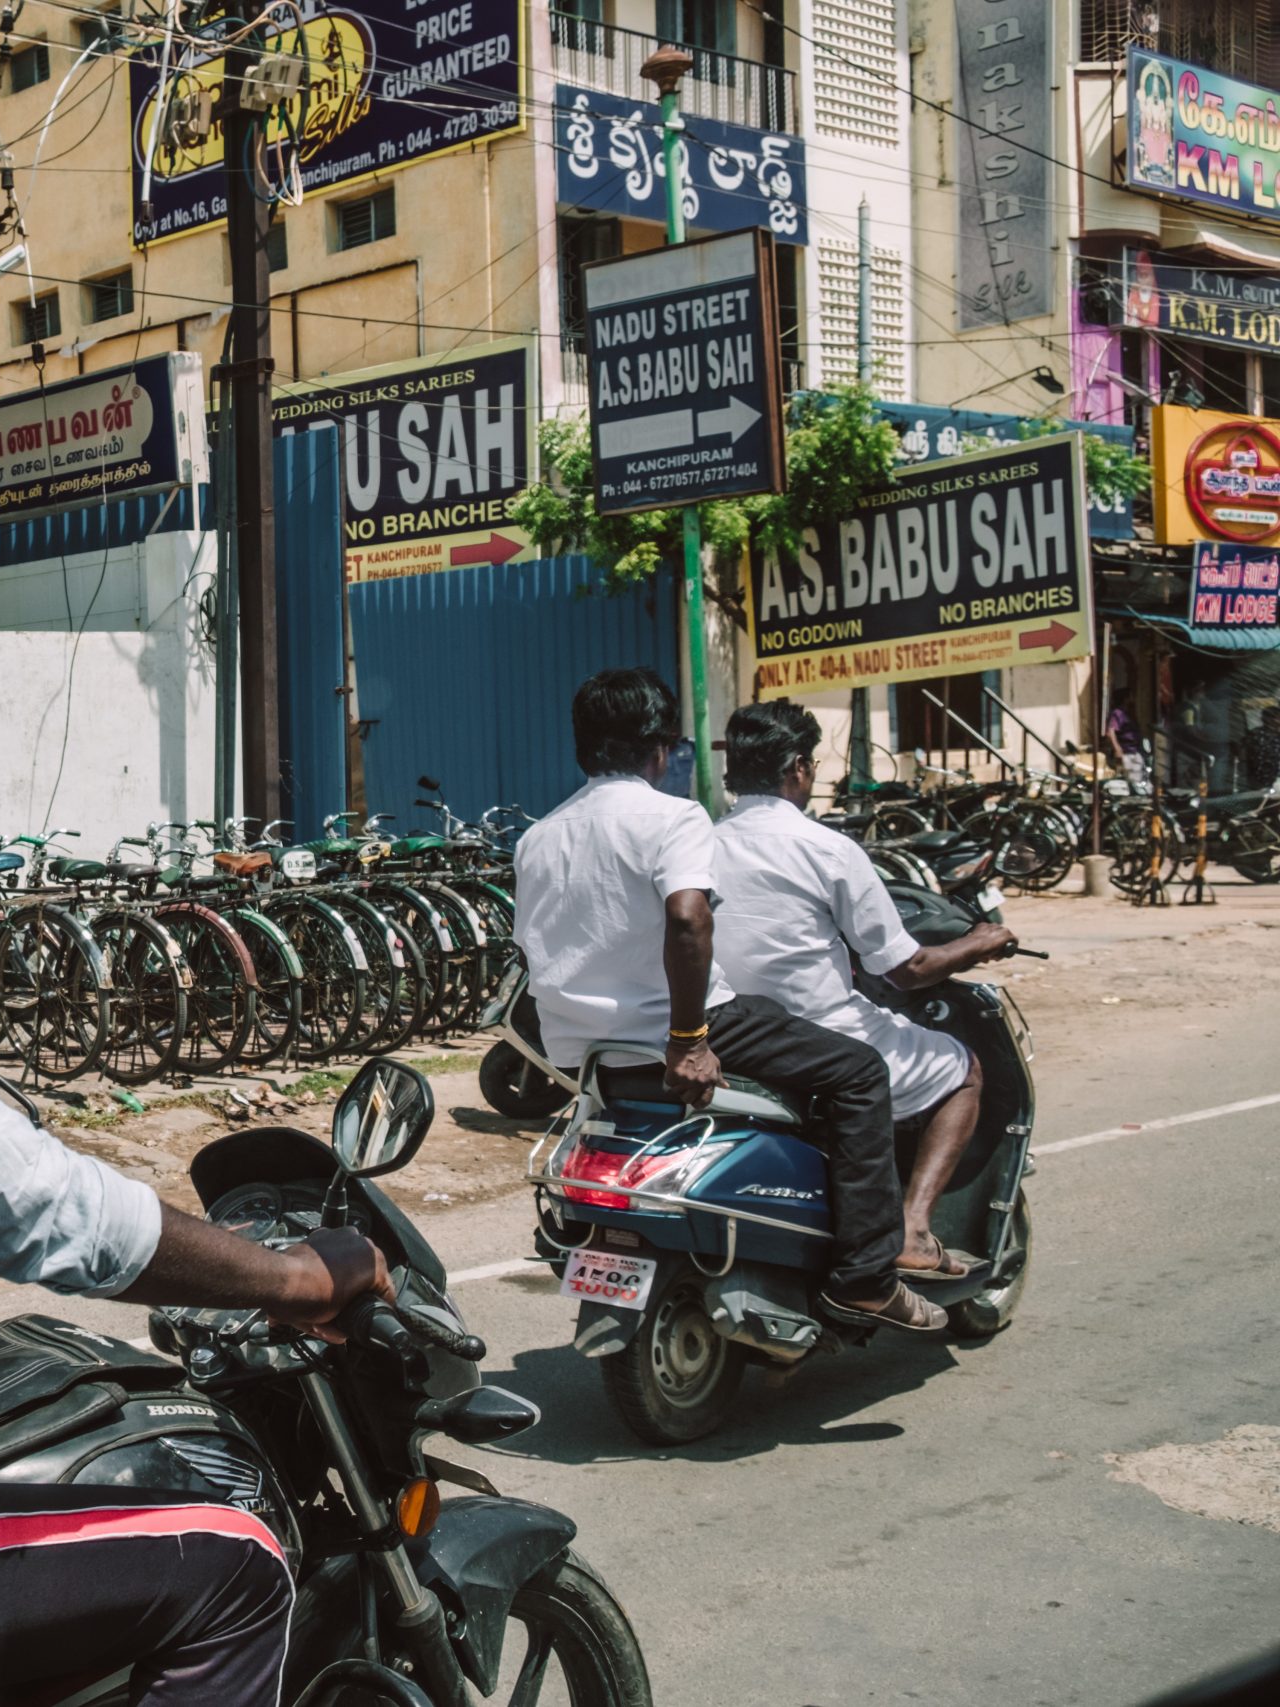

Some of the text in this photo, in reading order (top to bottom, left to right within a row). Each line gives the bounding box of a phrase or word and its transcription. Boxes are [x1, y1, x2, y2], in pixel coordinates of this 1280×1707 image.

[416, 3, 473, 49] PRICE
[382, 33, 511, 102] GUARANTEED
[378, 140, 396, 163] Ph
[407, 127, 433, 154] 044
[443, 112, 478, 141] 4720
[481, 101, 517, 128] 3030
[1177, 140, 1241, 201] KM
[160, 212, 172, 231] at
[174, 201, 209, 227] No.16,
[595, 288, 751, 349] NADU STREET
[706, 333, 755, 391] SAH
[349, 383, 400, 406] SILKS
[404, 368, 476, 396] SAREES
[396, 383, 516, 505] SAH
[626, 447, 734, 475] KANCHIPURAM
[10, 458, 47, 477] சைவ
[932, 475, 975, 496] SILKS
[978, 462, 1040, 487] SAREES
[602, 484, 616, 498] Ph
[623, 480, 642, 495] 044
[382, 497, 518, 537] BRANCHES
[969, 478, 1069, 589] SAH
[367, 543, 442, 564] KANCHIPURAM
[939, 585, 1074, 625] NO BRANCHES
[1224, 593, 1277, 624] LODGE
[761, 620, 863, 651] NO GODOWN
[758, 661, 791, 689] ONLY
[796, 657, 816, 684] AT:
[853, 647, 891, 675] NADU
[896, 639, 946, 671] STREET
[146, 1404, 218, 1419] HONDA
